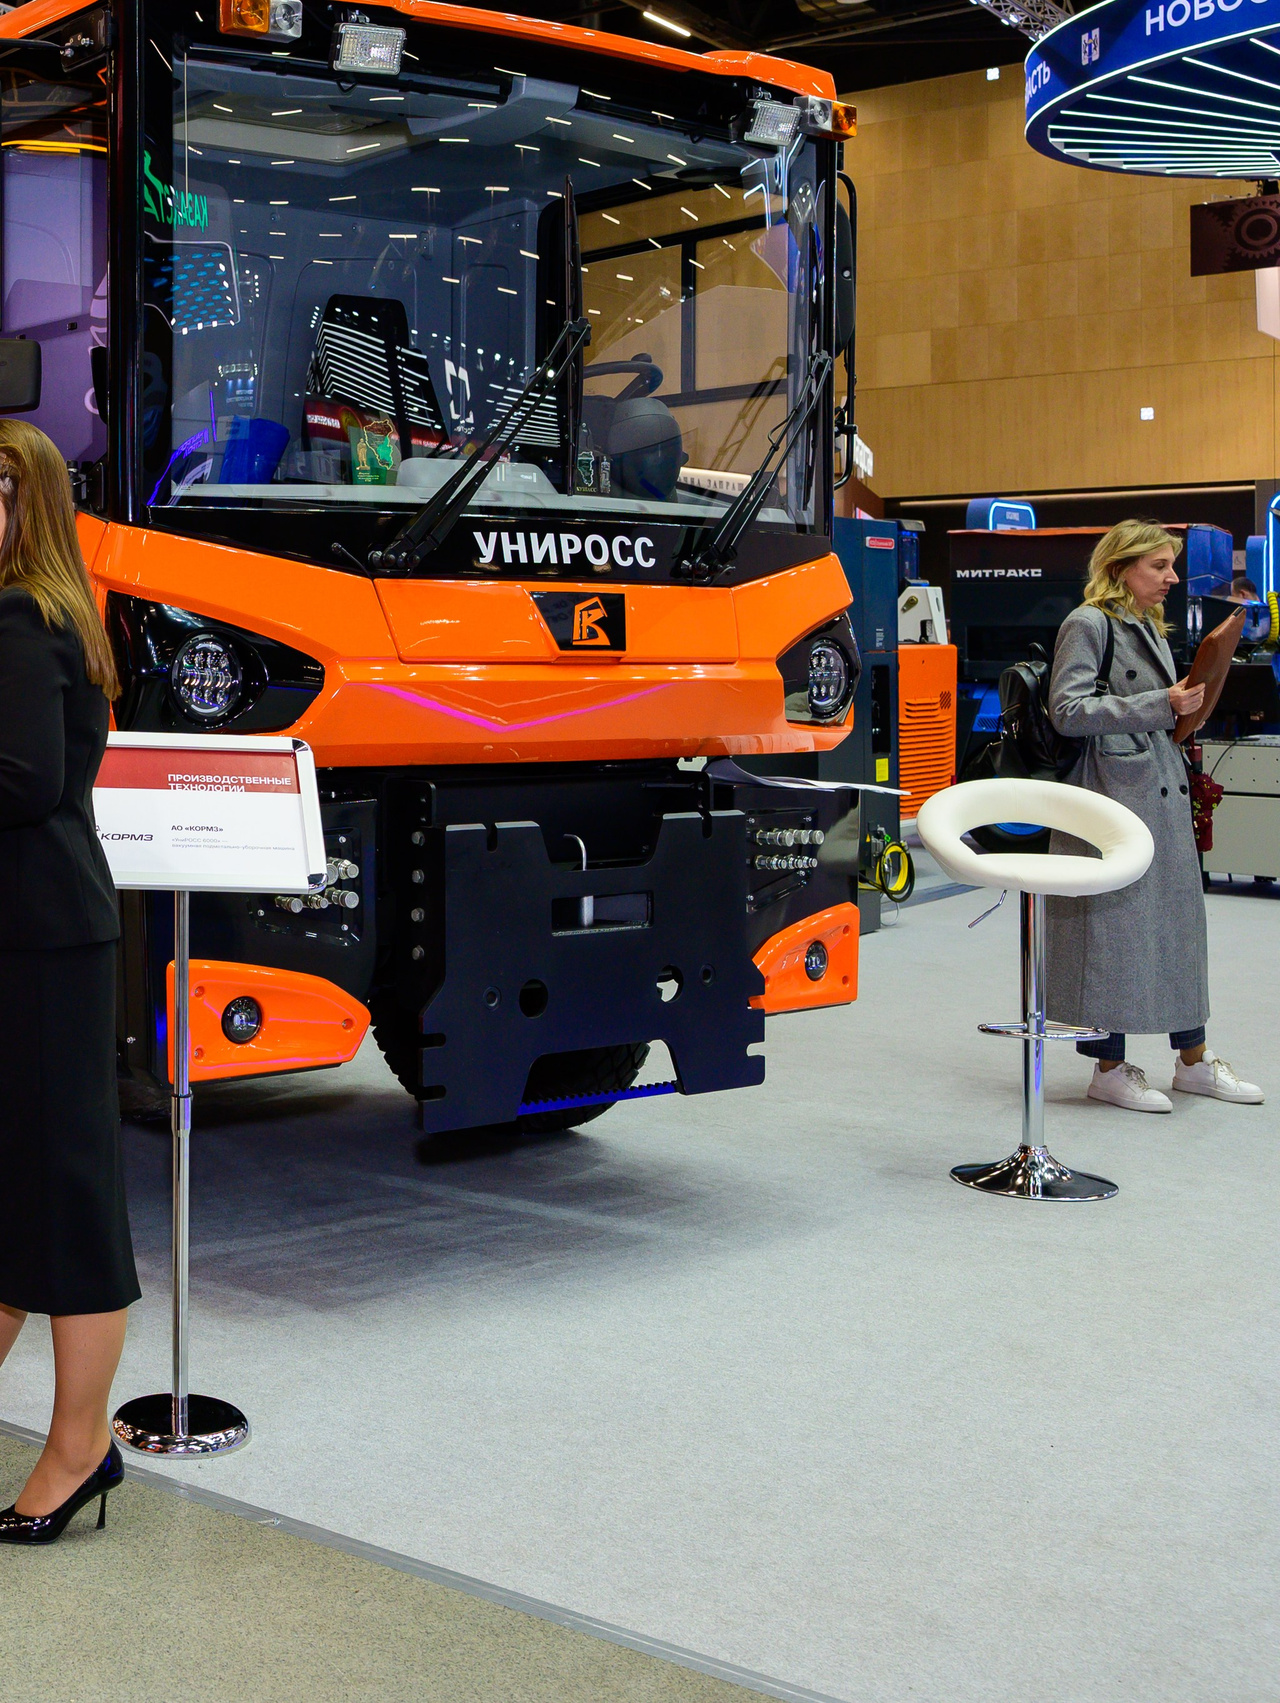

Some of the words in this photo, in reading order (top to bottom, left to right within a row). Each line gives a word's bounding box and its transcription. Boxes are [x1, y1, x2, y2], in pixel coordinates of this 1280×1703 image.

[1145, 0, 1269, 36] НОВ
[473, 531, 657, 568] УНИРОСС
[956, 568, 1042, 578] МИТРАКС
[167, 773, 292, 786] ПРОИЗВОДСТВЕННЫЕ
[168, 783, 246, 793] ТЕХНОЛОГИИ
[184, 825, 224, 833] «КОРМЗ»
[100, 832, 154, 842] КОРМЗ
